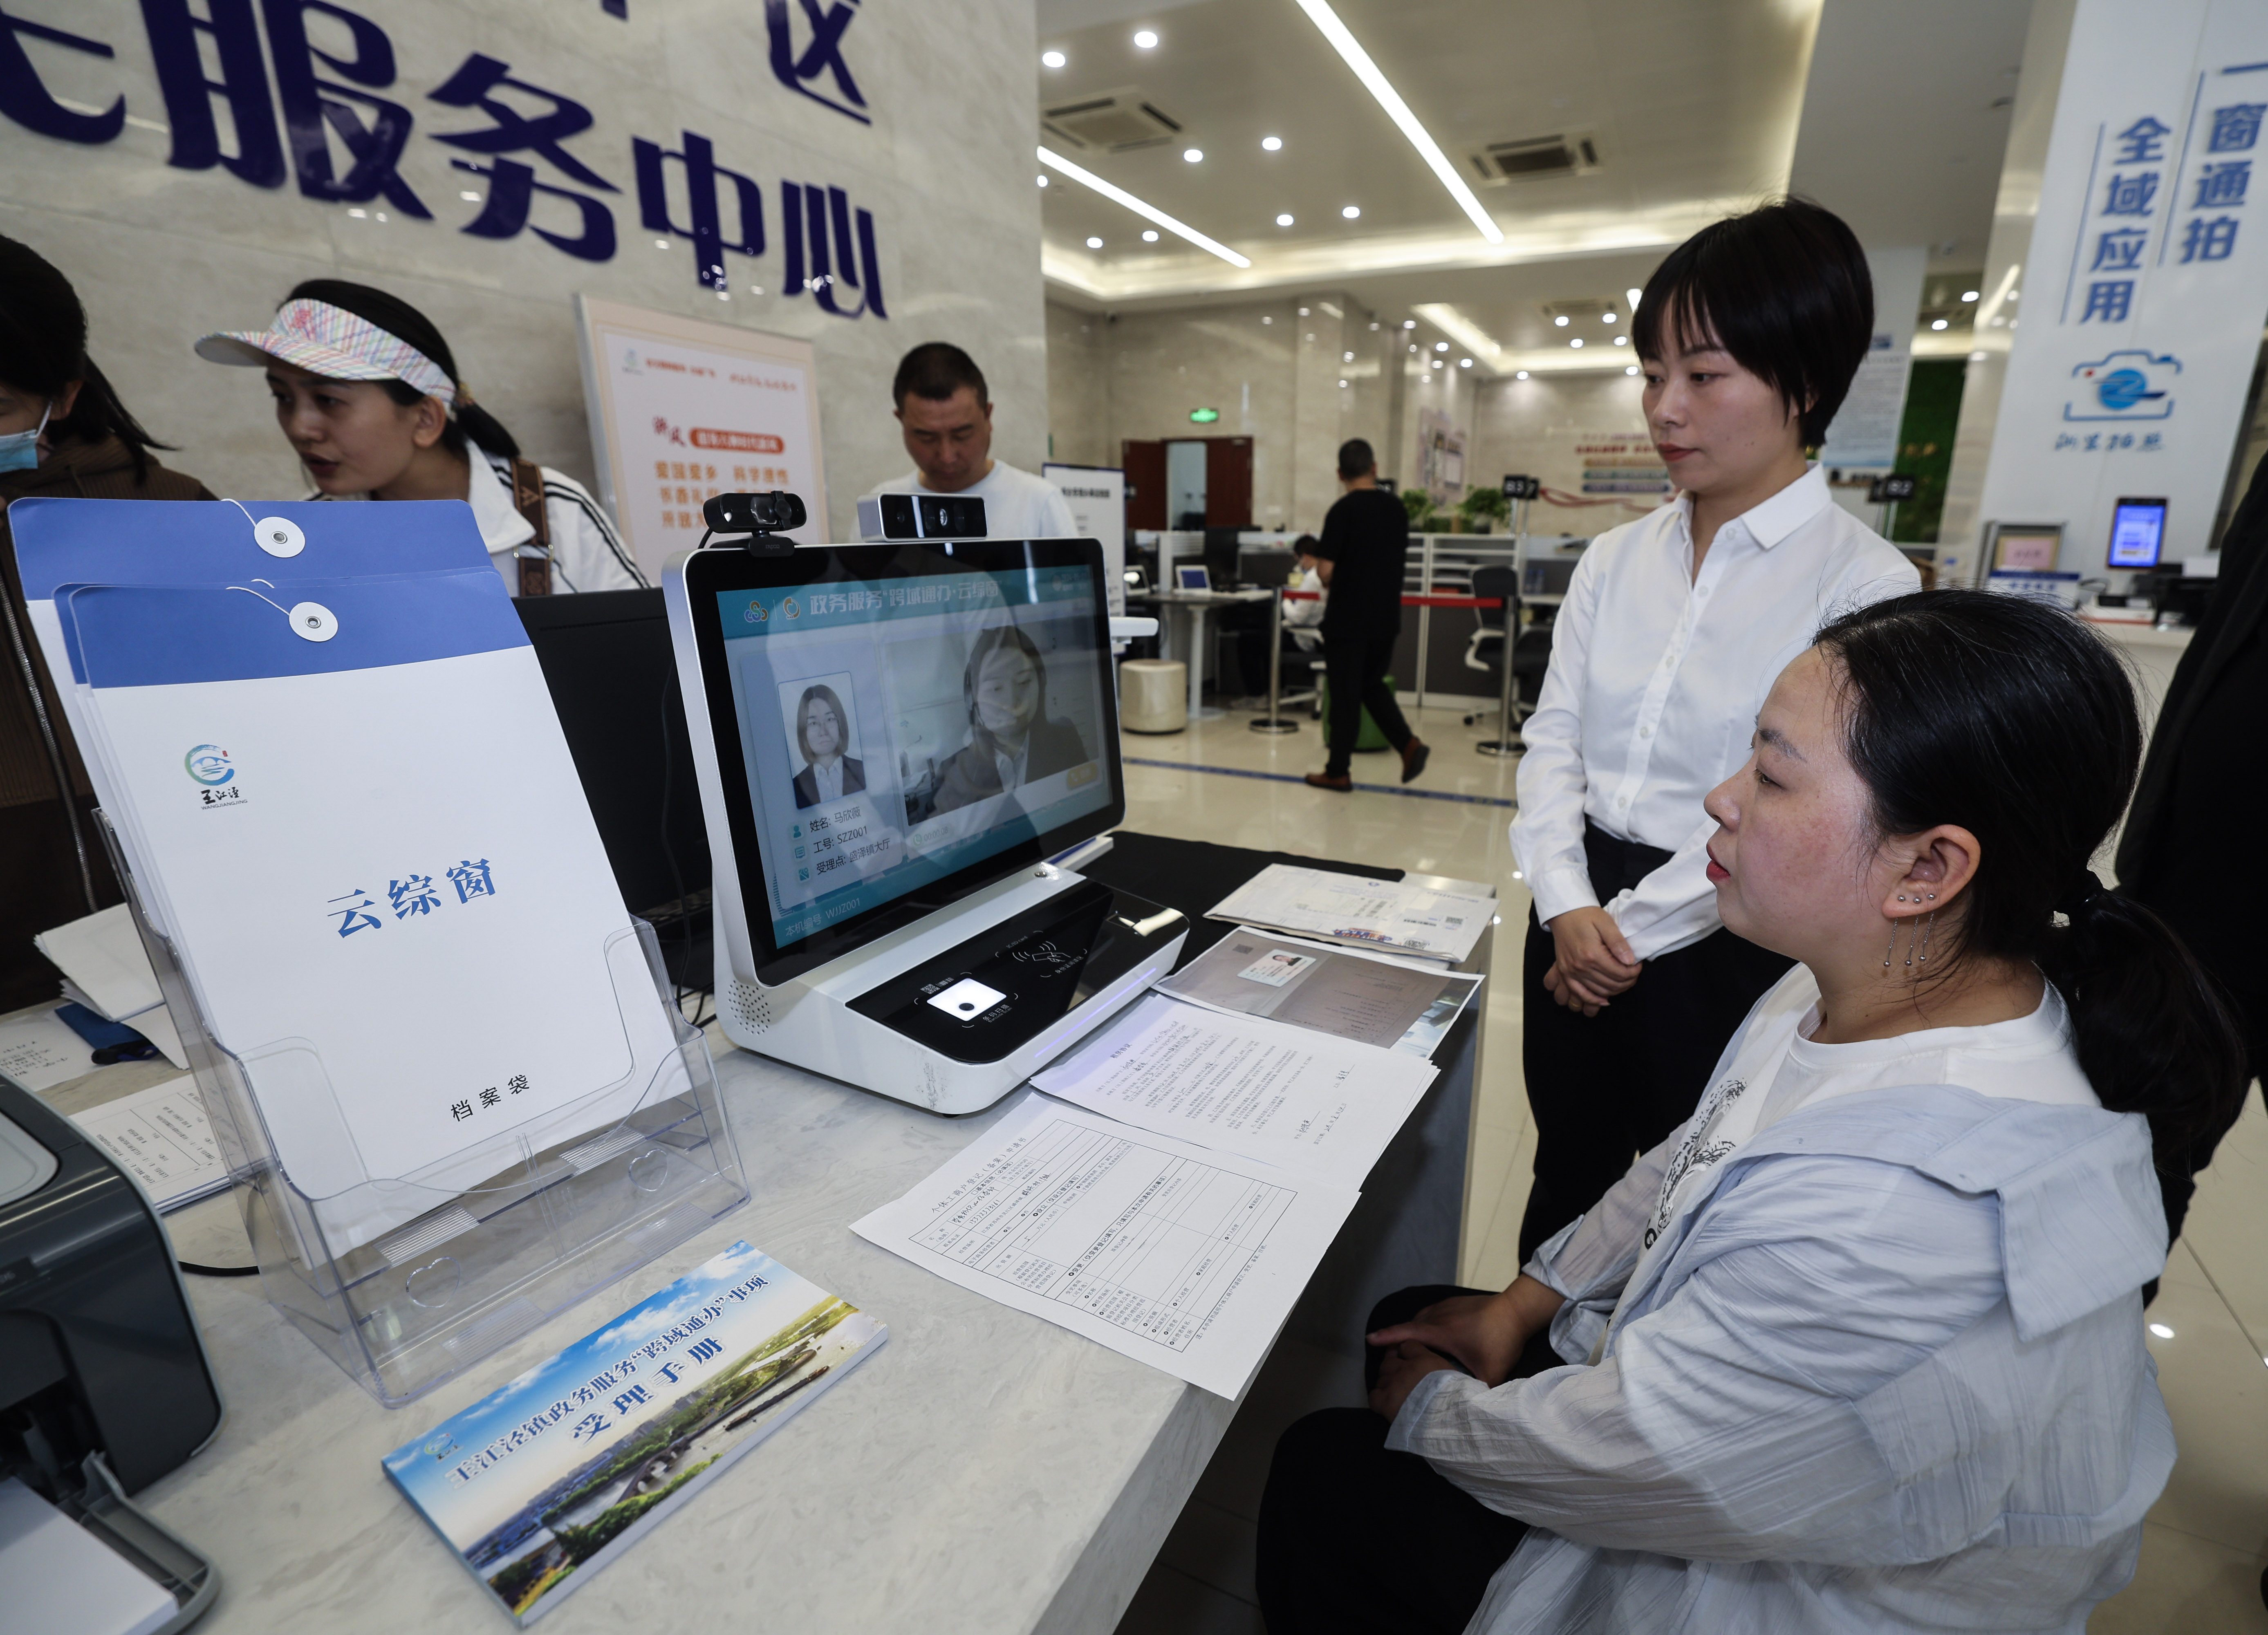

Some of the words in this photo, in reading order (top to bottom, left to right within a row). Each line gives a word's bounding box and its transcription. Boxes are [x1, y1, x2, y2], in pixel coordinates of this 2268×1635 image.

[2080, 116, 2172, 324] 全域应用
[201, 799, 248, 810] WANGJIANGJING
[837, 826, 867, 844] SZZ001
[849, 838, 891, 863] 盛泽镇大厅
[327, 858, 496, 939] 云综窗
[785, 914, 822, 937] 本机编号
[982, 1004, 1010, 1022] 条码扫描
[450, 1074, 530, 1122] 档案袋
[928, 1137, 1030, 1214] 个体工商户登记（备案）申请书
[957, 1239, 976, 1254] 经营场所
[1019, 1261, 1047, 1286] 公布的经营项目
[1086, 1287, 1097, 1296] 名称
[1094, 1288, 1111, 1304] 经营场所
[1174, 1287, 1190, 1303] 个人经营
[1153, 1312, 1170, 1330] 组成形式
[1165, 1318, 1179, 1332] 经营者
[570, 1336, 725, 1447] 受理手册
